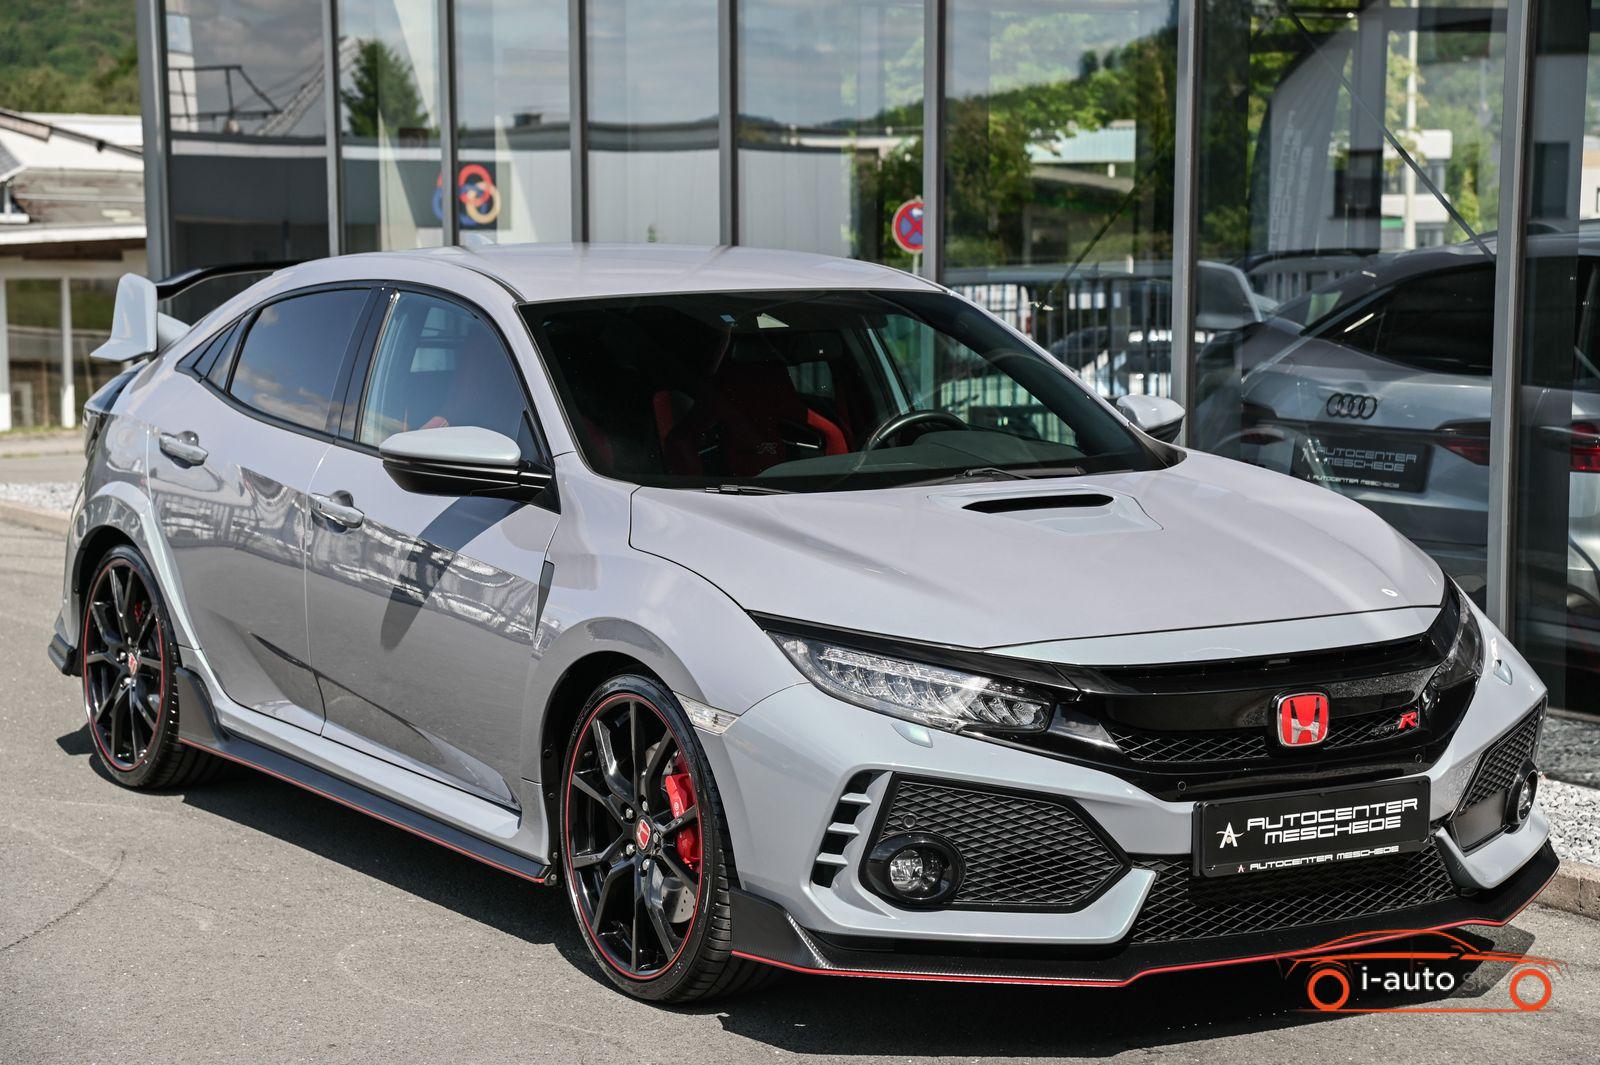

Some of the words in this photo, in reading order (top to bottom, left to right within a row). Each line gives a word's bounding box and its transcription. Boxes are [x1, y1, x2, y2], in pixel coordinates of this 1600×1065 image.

[1316, 446, 1417, 463] AUTOCENTER
[1324, 457, 1405, 472] MESCHEDE
[1247, 798, 1418, 831] AUTOCENTER
[1264, 815, 1402, 845] MESCHEDE
[1250, 854, 1334, 871] AUTOCENTER
[1336, 845, 1400, 860] MESCHEDE
